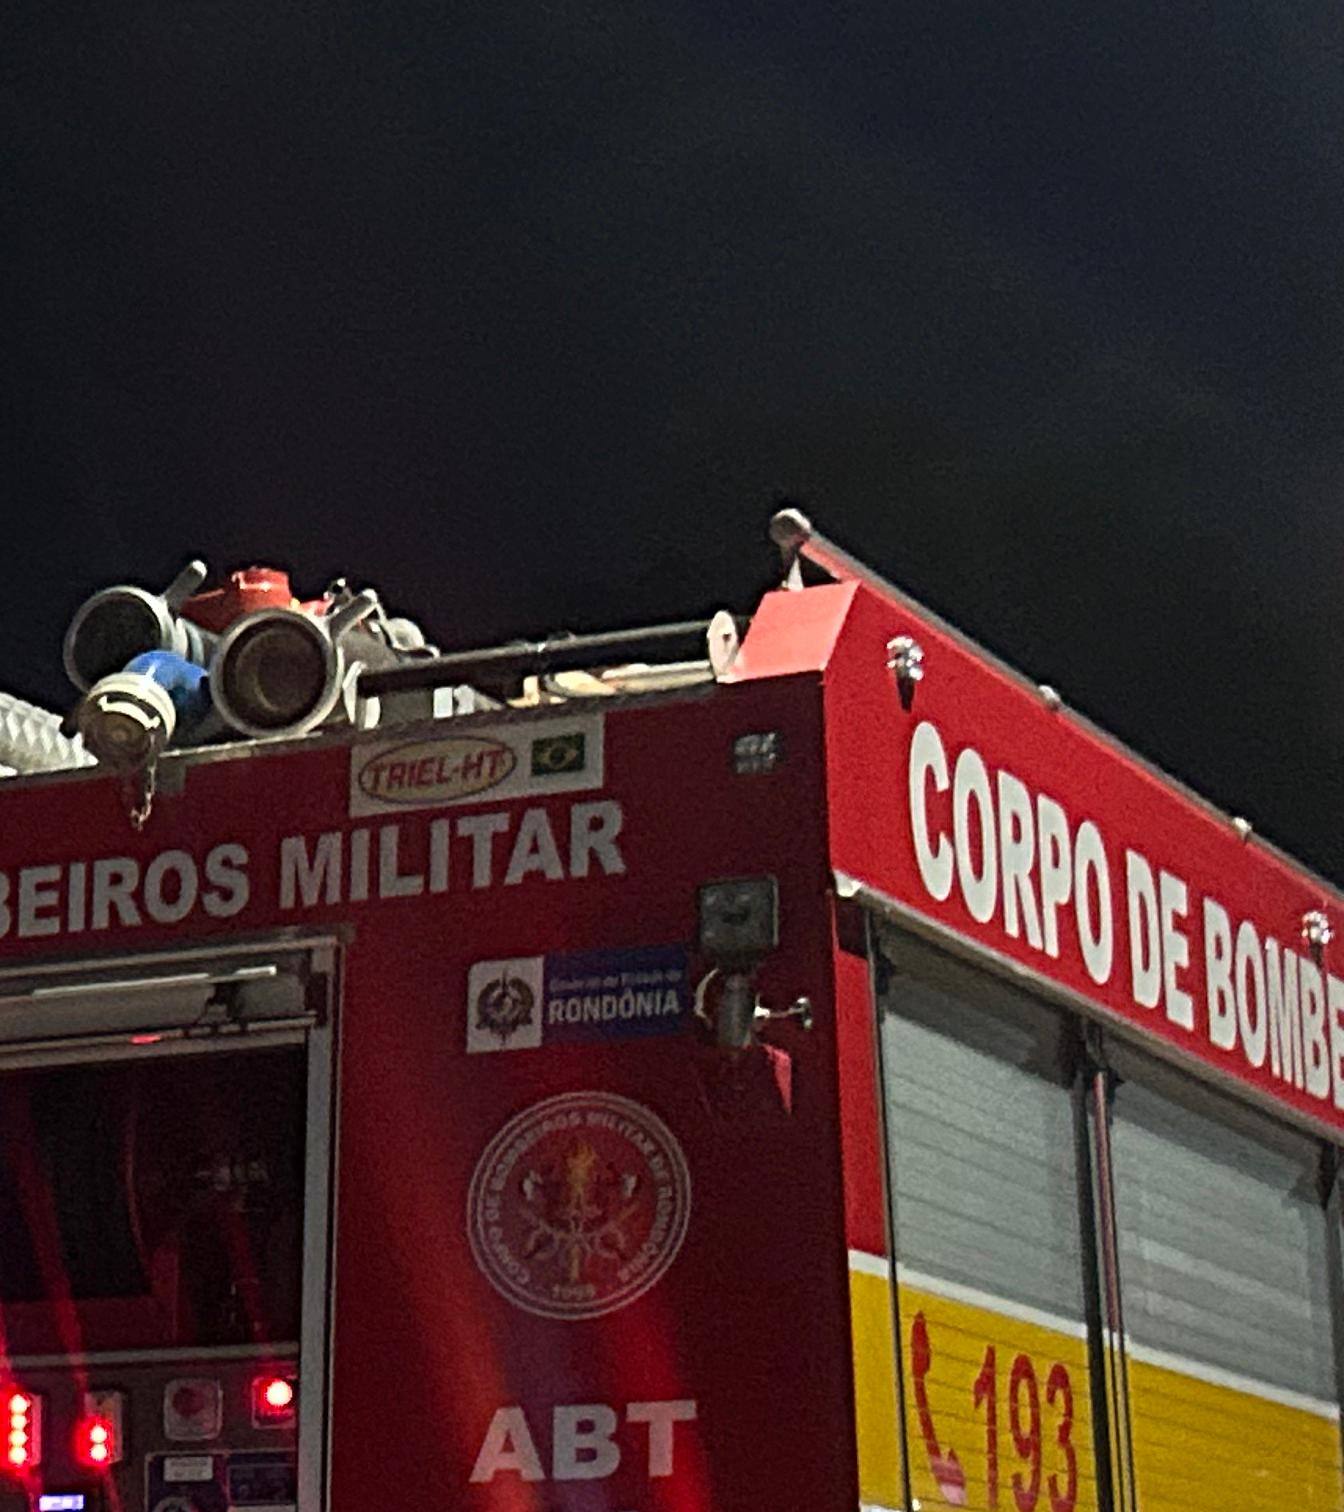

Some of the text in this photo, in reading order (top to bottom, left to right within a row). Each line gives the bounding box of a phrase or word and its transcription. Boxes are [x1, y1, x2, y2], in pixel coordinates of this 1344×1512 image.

[366, 737, 508, 790] TRIEL-HT
[279, 799, 627, 910] MILITAR
[909, 721, 1113, 985] CORPO
[1126, 849, 1194, 1031] DE
[469, 1400, 697, 1484] ABT
